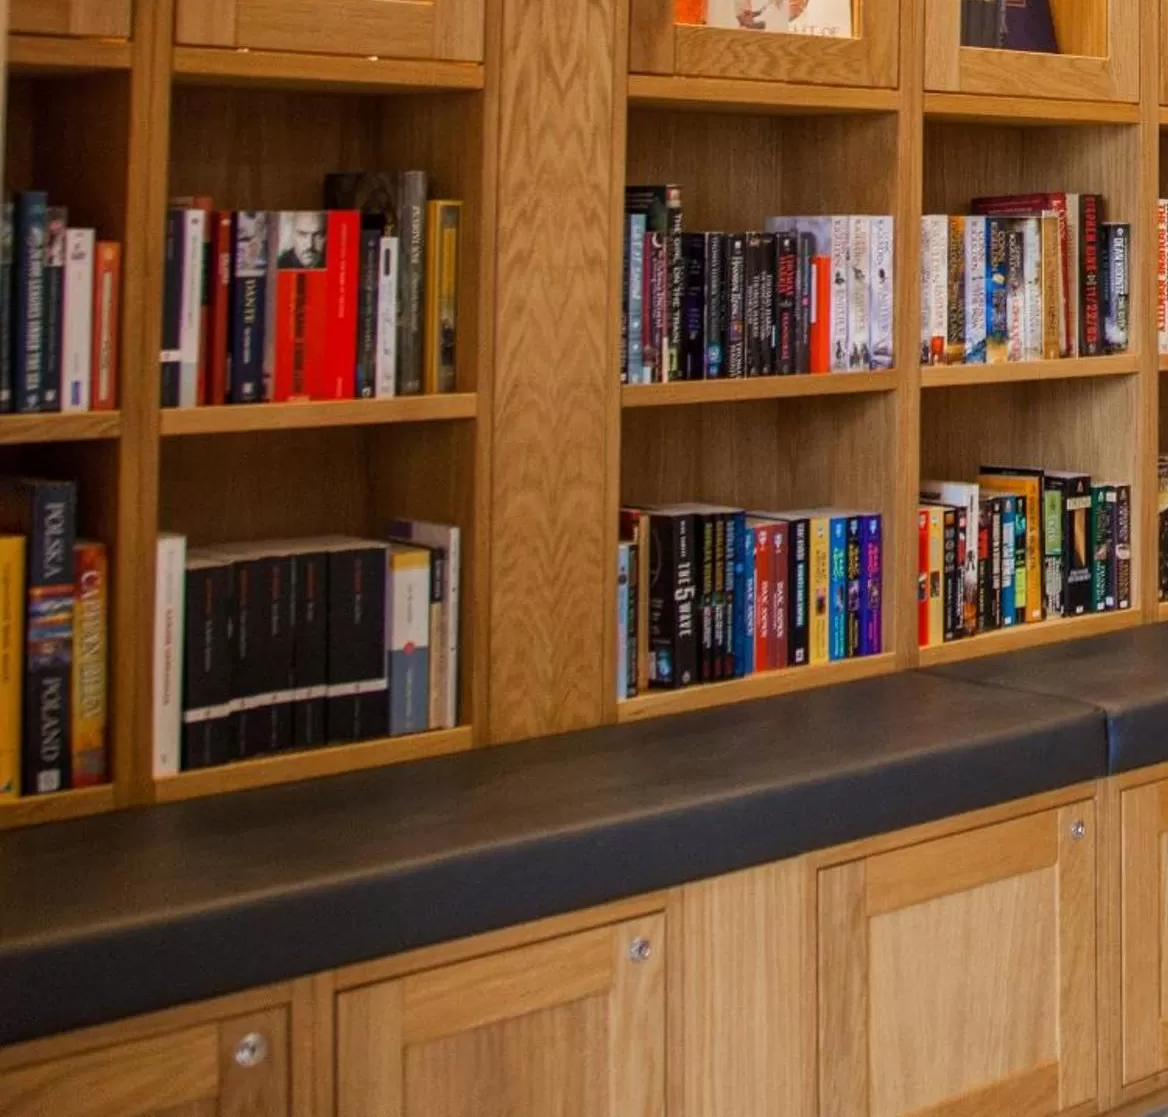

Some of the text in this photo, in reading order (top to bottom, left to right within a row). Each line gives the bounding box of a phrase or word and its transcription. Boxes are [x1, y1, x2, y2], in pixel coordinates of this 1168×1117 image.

[244, 278, 257, 323] DANTE
[671, 213, 683, 344] THE GIRL ON THE TRAIN
[43, 500, 66, 579] POLSKA
[674, 561, 697, 638] THE 5 WAVE
[39, 675, 62, 762] POLAND
